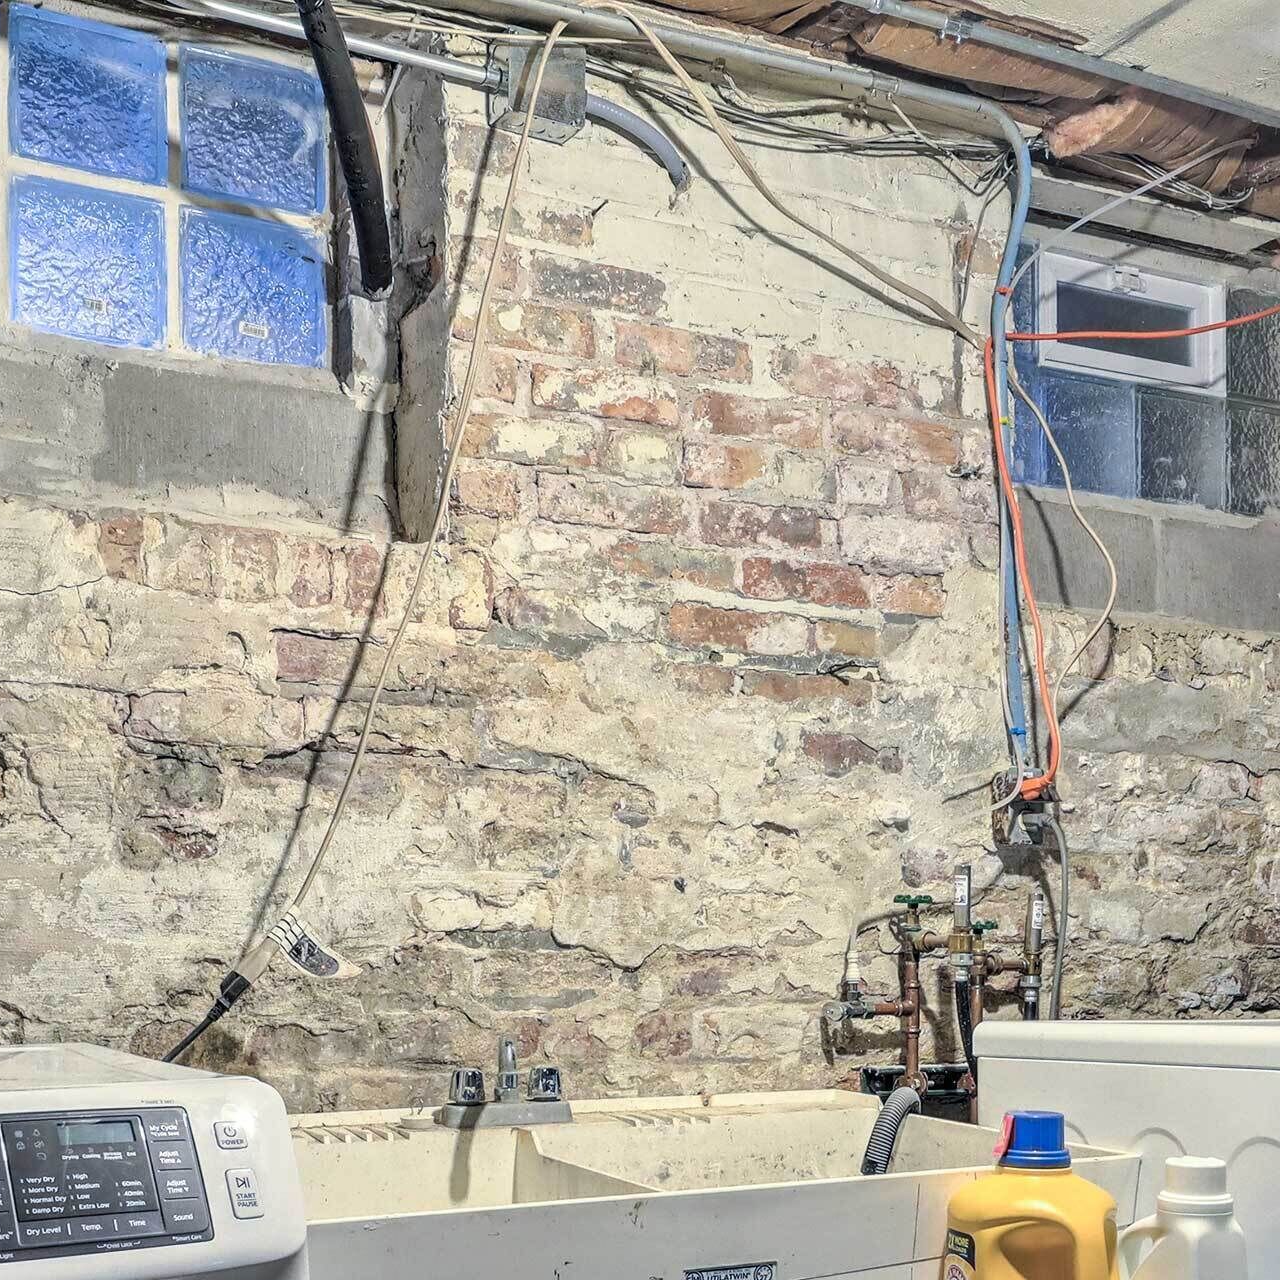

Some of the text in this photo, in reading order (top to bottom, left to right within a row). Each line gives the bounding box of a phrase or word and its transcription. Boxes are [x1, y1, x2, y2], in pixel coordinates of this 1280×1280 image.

[159, 1150, 179, 1158] Adjust
[72, 1173, 88, 1181] High
[166, 1180, 186, 1188] Adjust
[46, 1185, 59, 1193] Dry
[55, 1195, 67, 1203] Dry
[31, 1205, 65, 1215] Damp Dry
[79, 1202, 95, 1210] Extra
[173, 1213, 193, 1221] Sound
[81, 1222, 104, 1231] Temp.
[26, 1226, 62, 1236] Dry Level
[0, 1252, 14, 1261] Light
